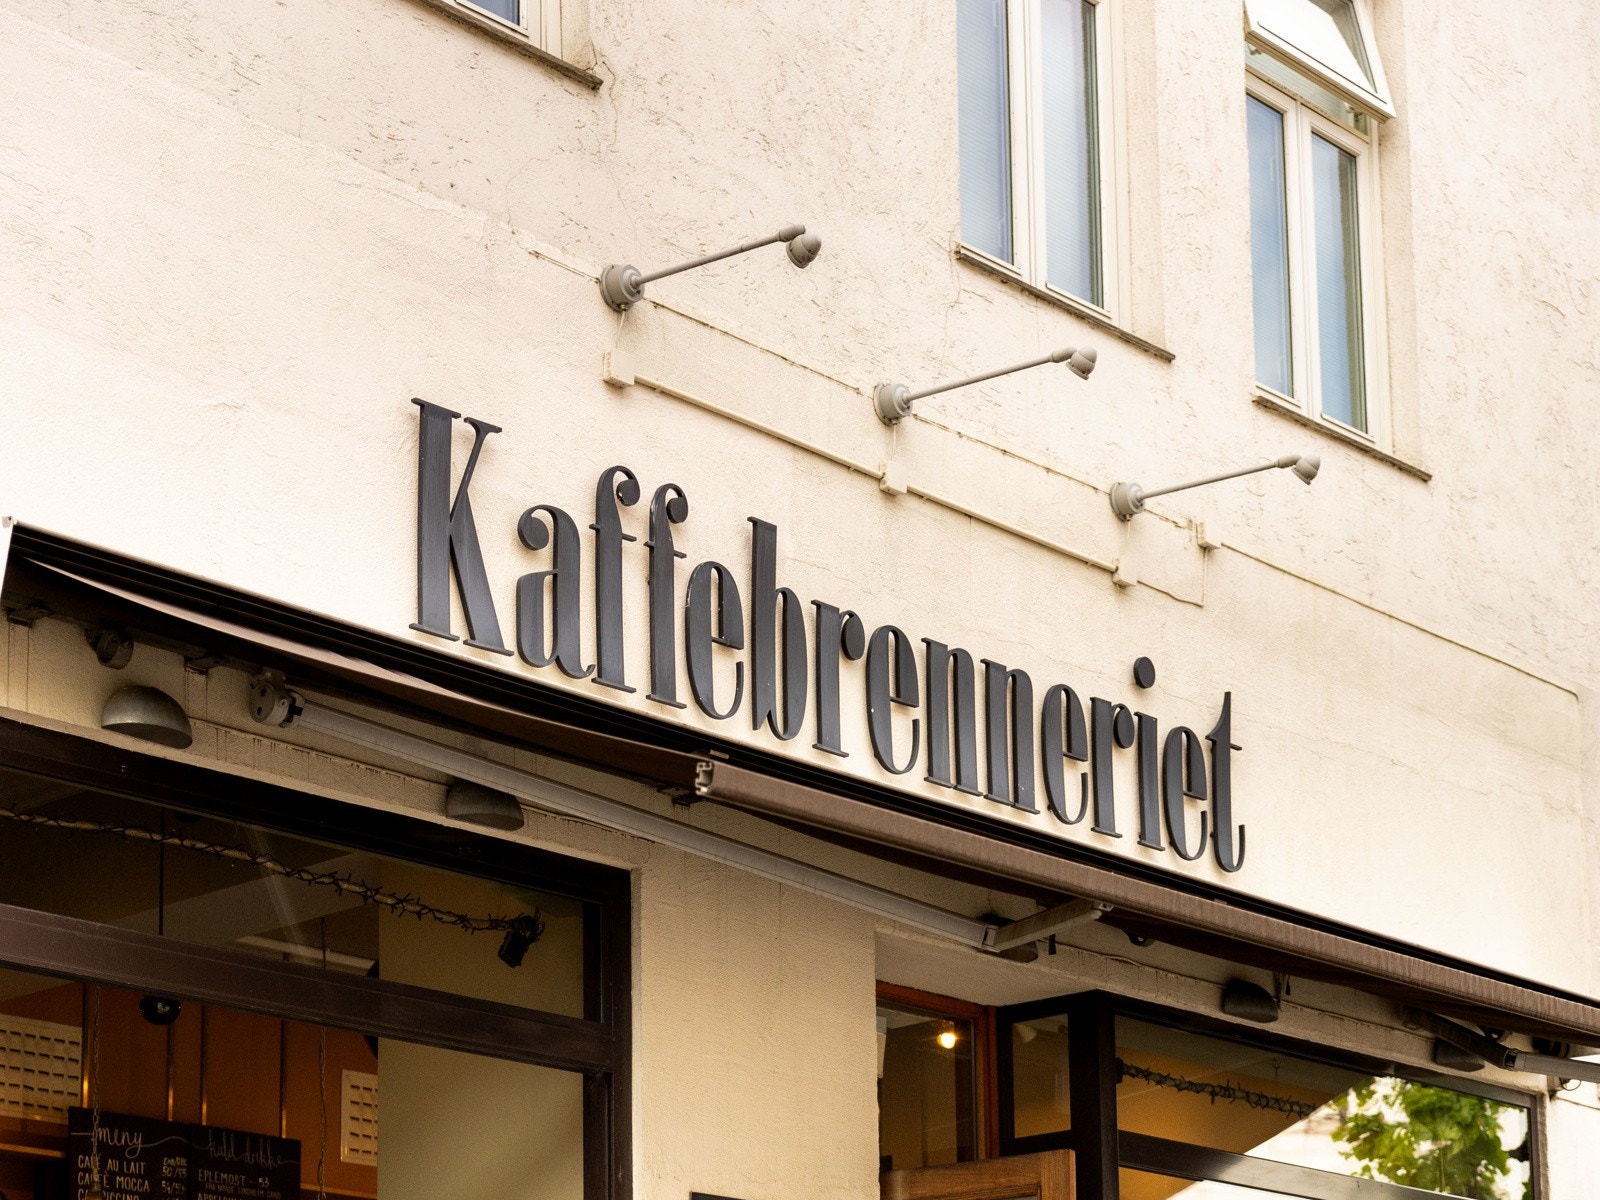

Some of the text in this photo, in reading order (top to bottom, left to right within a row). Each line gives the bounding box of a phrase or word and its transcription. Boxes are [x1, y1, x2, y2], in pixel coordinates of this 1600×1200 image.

[409, 397, 1246, 873] Kaffebrenneriet
[106, 1158, 119, 1172] AU
[123, 1160, 146, 1175] LAIT
[116, 1175, 150, 1192] MOCCA
[198, 1169, 247, 1187] EPLEMOST
